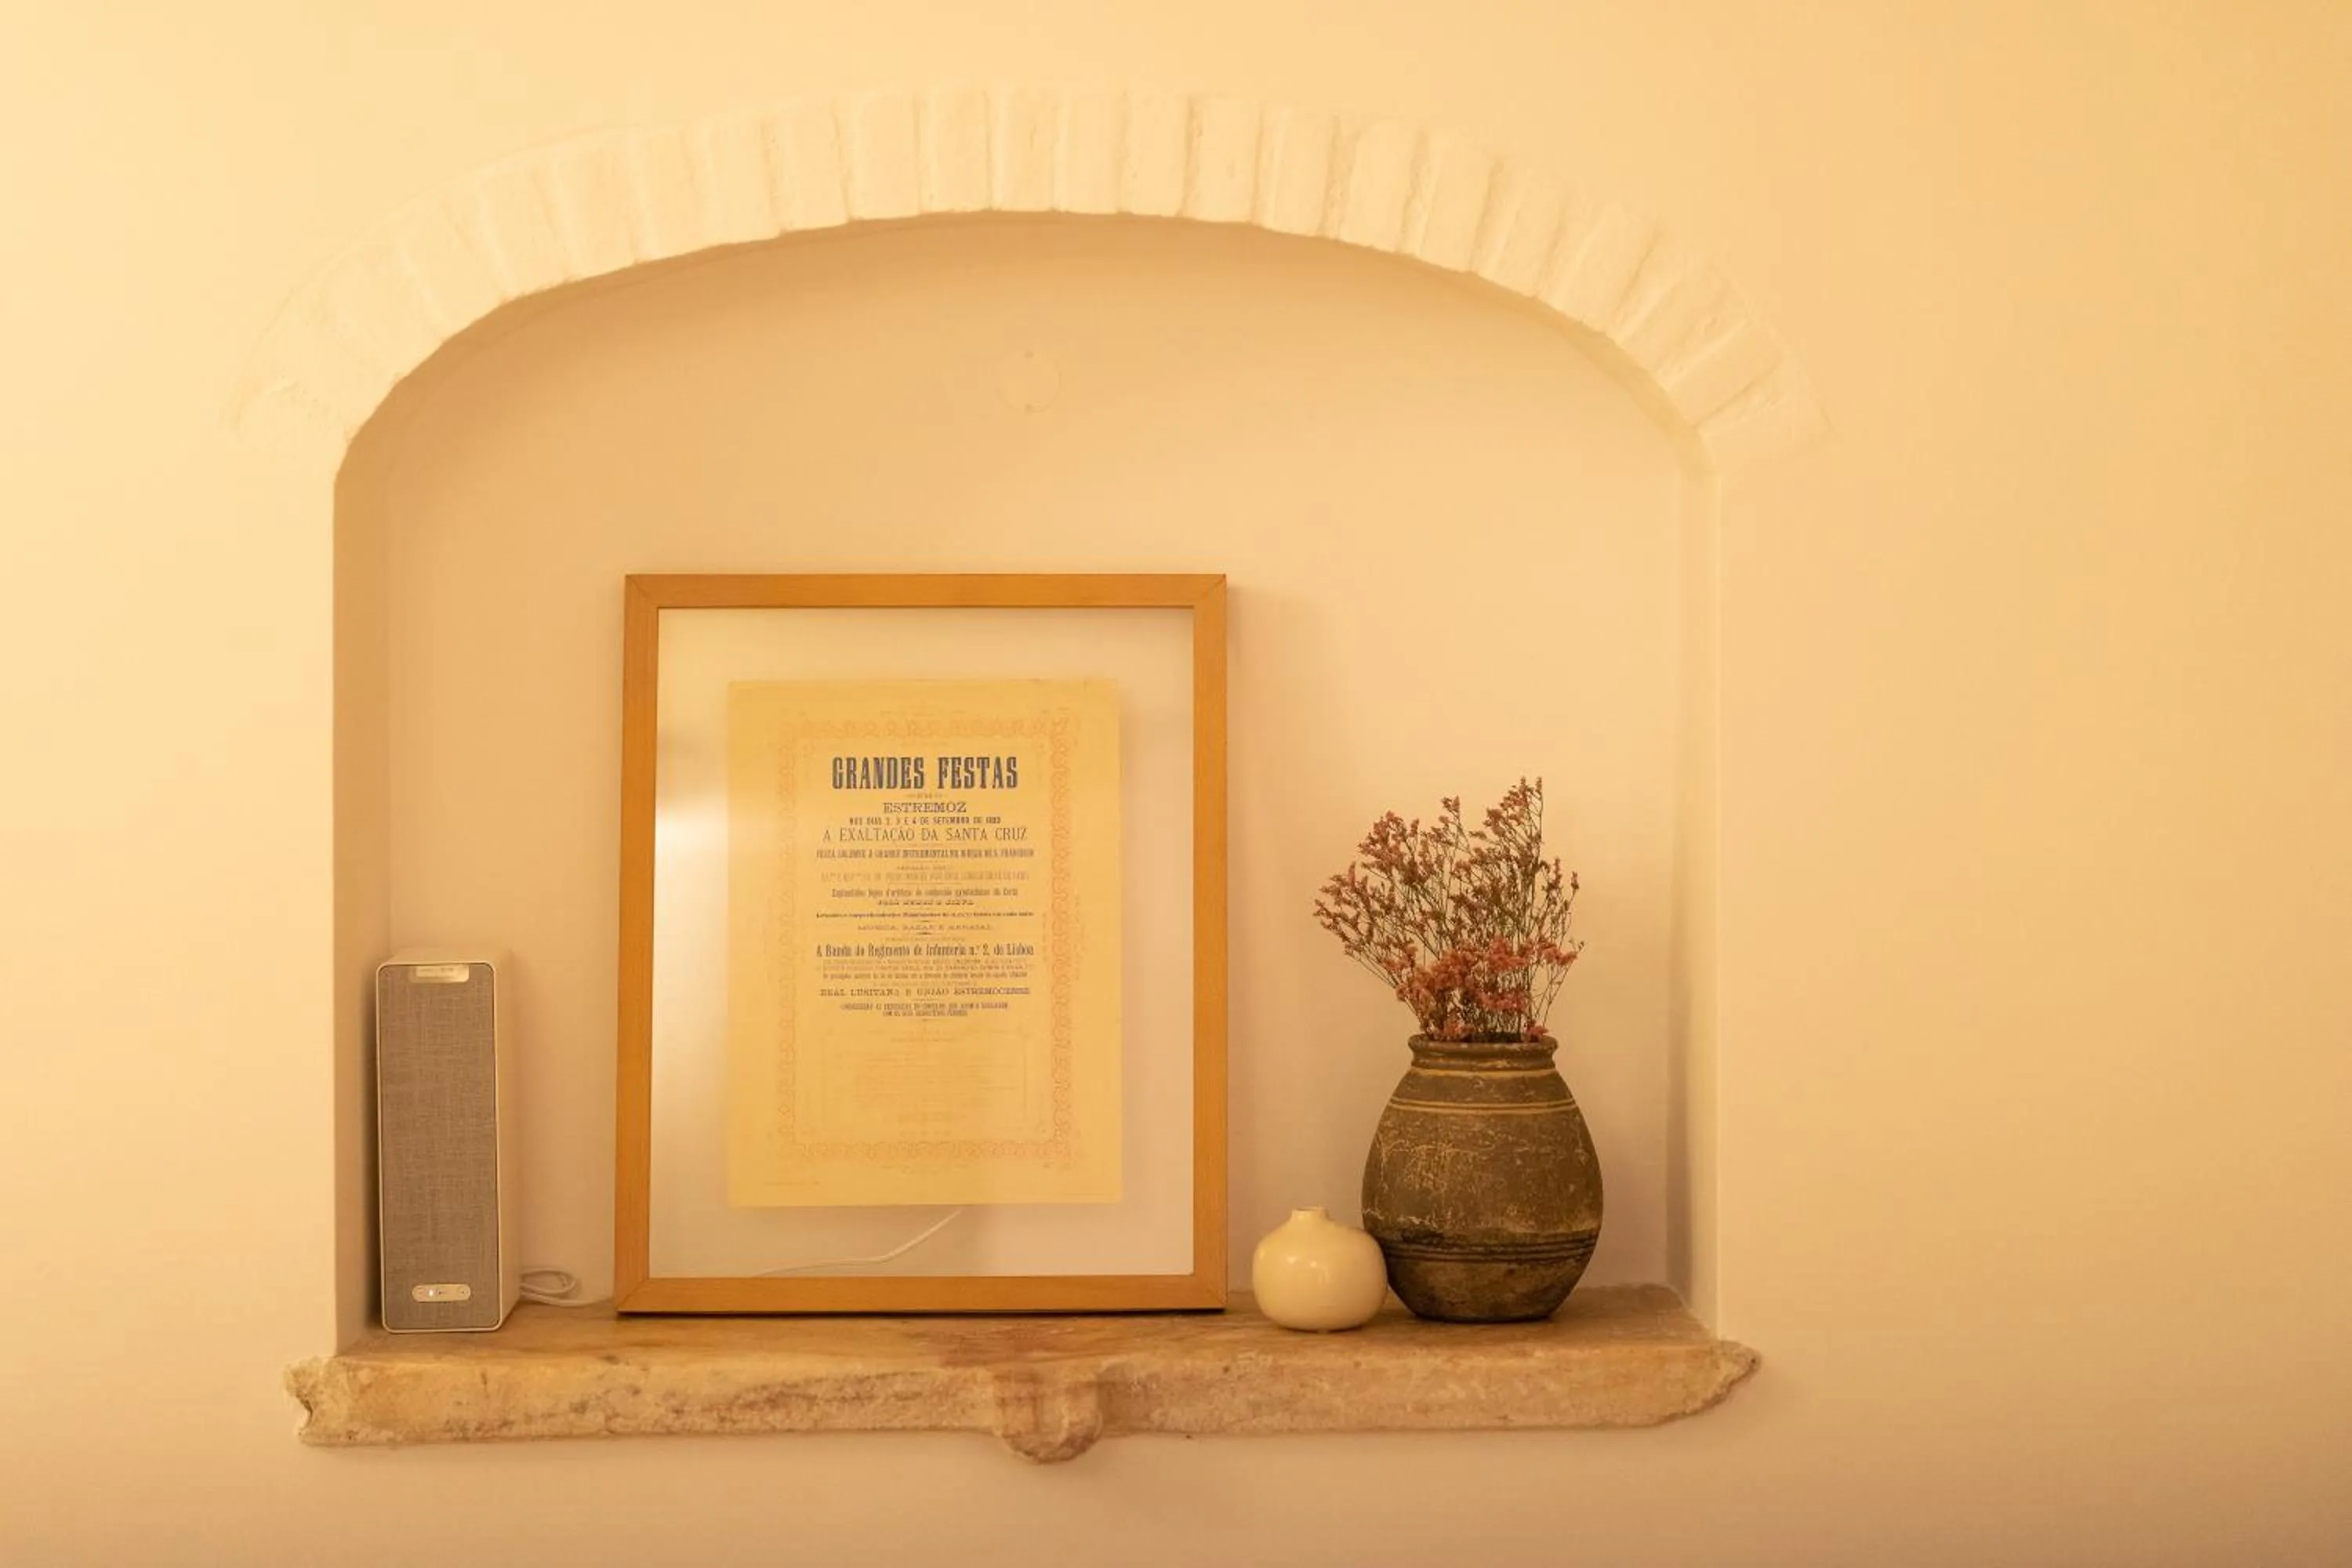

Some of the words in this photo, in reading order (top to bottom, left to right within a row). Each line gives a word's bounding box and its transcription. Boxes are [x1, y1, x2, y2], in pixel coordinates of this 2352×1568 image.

[832, 757, 924, 789] GRANDES
[937, 757, 1018, 789] FESTAS
[883, 802, 967, 813] ESTREMOZ
[933, 816, 969, 825] SETEMBRO
[823, 828, 831, 841] A
[840, 826, 915, 844] EXALTAÇÃO
[921, 827, 938, 841] DA
[946, 827, 988, 841] SANTA
[995, 827, 1028, 841] CRUZ
[816, 944, 822, 957] A
[826, 944, 851, 956] Banda
[868, 943, 909, 958] Regimento
[1007, 942, 1034, 956] Lisboa
